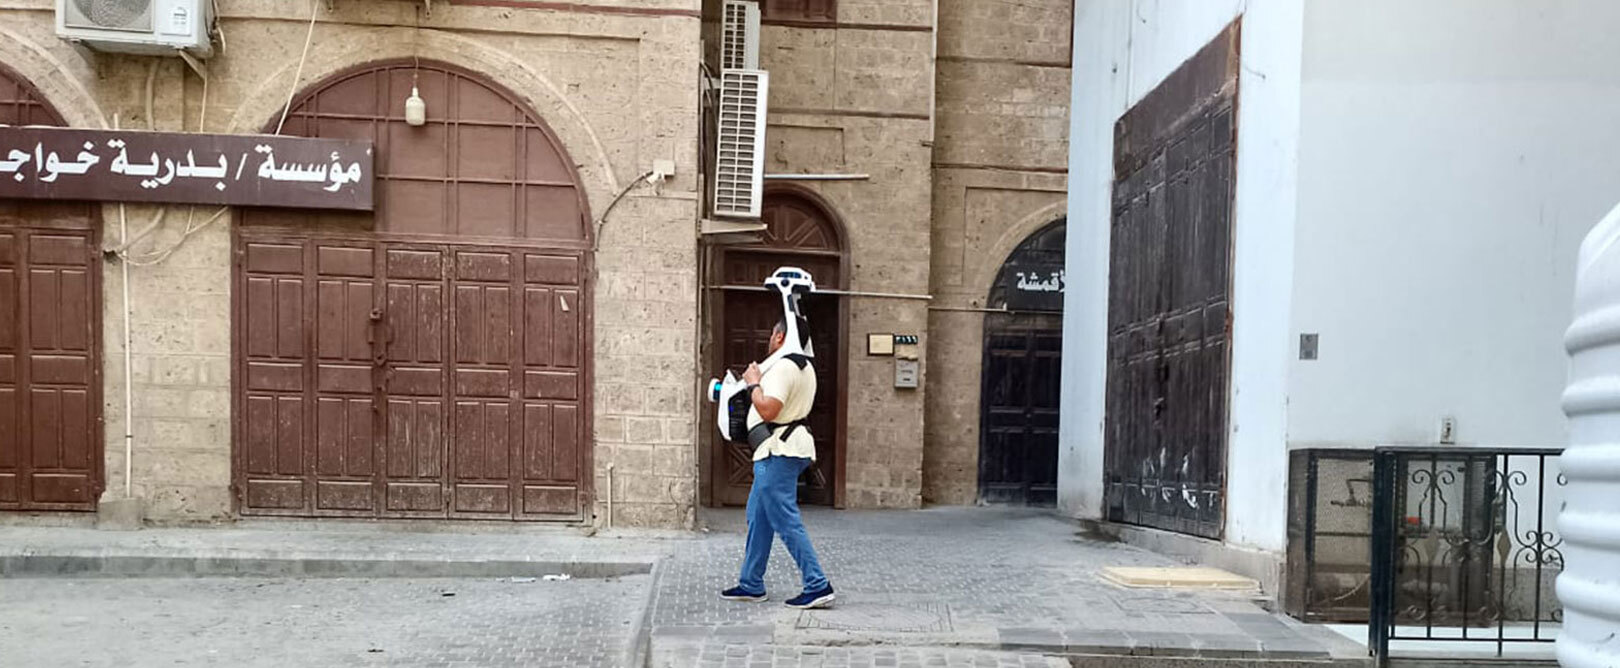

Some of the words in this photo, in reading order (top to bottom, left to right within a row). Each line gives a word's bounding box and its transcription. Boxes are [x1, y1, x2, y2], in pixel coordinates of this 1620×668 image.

[0, 141, 100, 183] خواج
[107, 138, 228, 191] بدرية
[255, 144, 362, 192] مؤسسة
